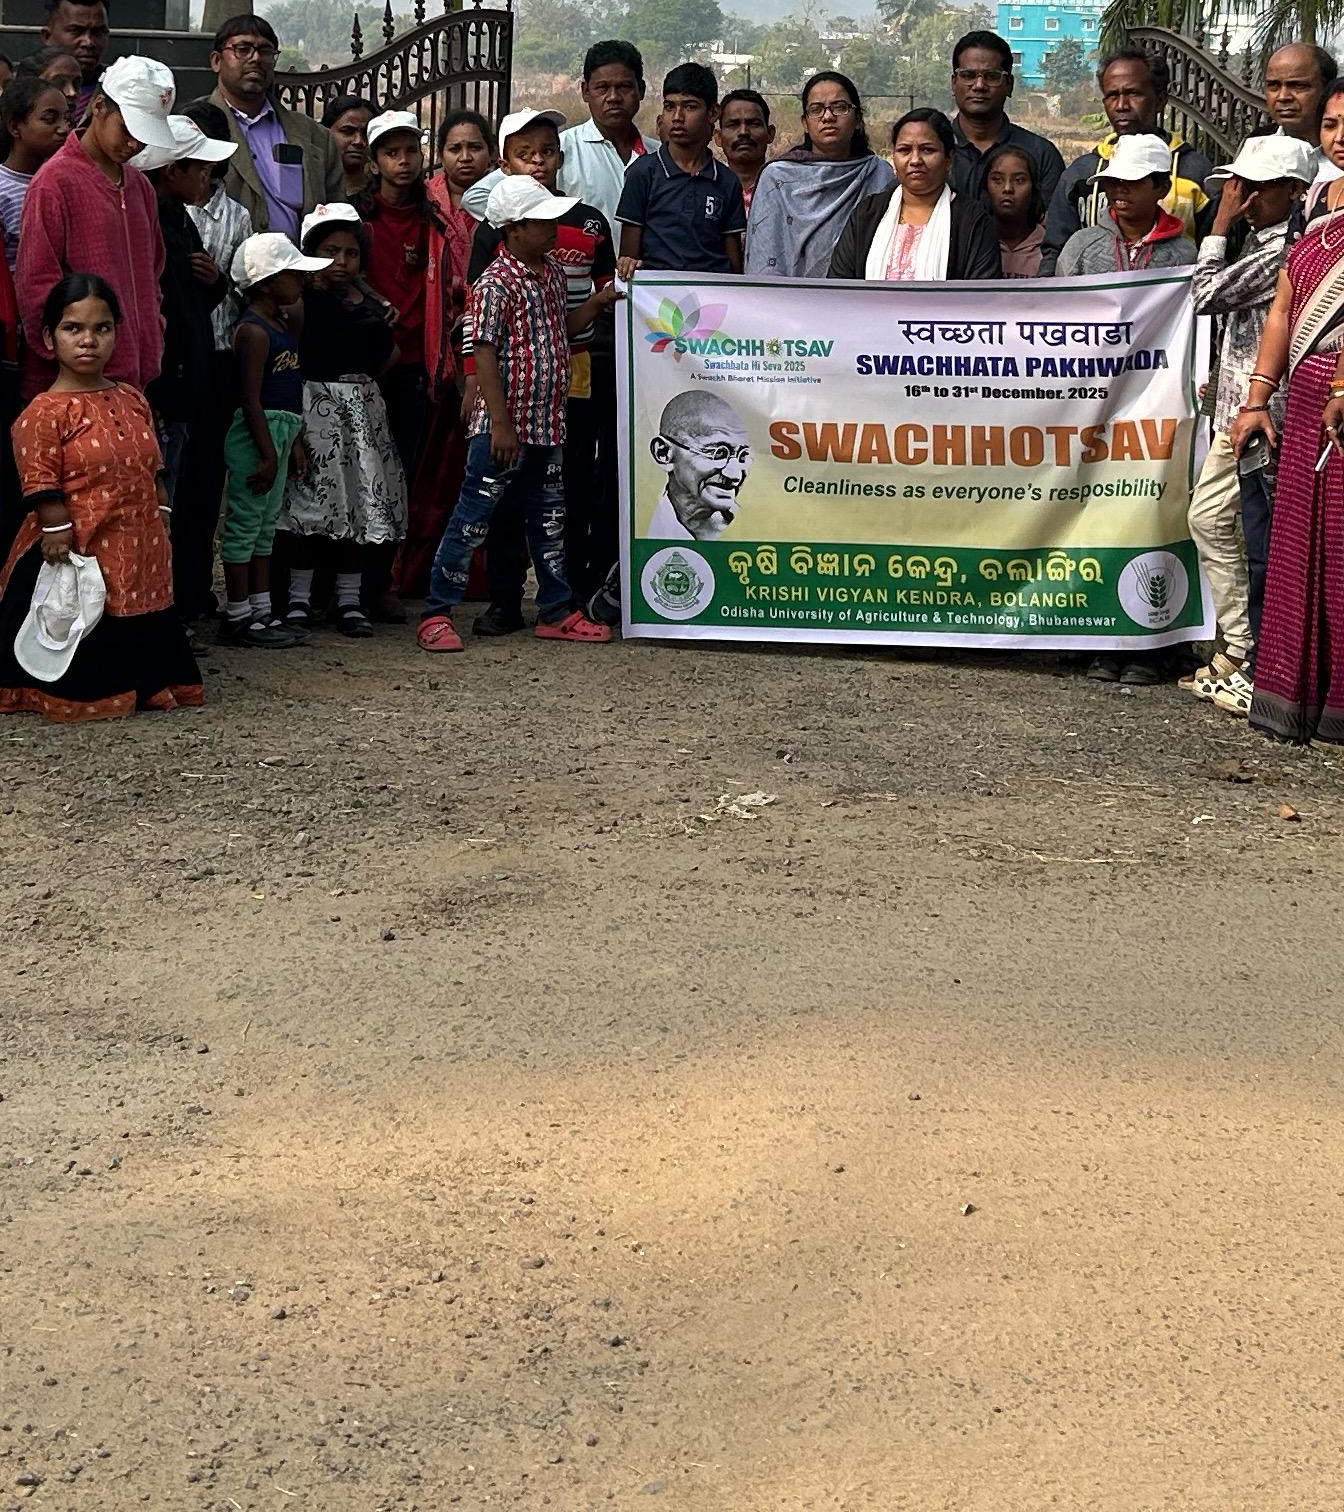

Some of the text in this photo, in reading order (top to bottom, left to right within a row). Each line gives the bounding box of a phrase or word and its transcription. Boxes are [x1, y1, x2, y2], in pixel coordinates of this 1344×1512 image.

[898, 320, 1007, 346] स्वच्छता
[784, 361, 806, 371] 2025
[856, 354, 1020, 377] SWACHHATA
[904, 385, 930, 398] 16th
[933, 386, 948, 398] to
[952, 386, 979, 399] 31st
[1067, 387, 1109, 400] 2025
[768, 418, 1178, 467] SWACHHOTSAV
[783, 476, 897, 499] Cleanliness
[902, 484, 926, 500] as
[1048, 478, 1168, 502] resposibility
[728, 545, 778, 585] କୃଷି
[789, 545, 876, 577] ବିଜ୍ଞାନ
[745, 586, 1089, 609] KRISHI VIGYAN KENDRA, BOLANGIR
[720, 606, 1117, 629] Odisha University of Agriculture & Technology, Bhubaneswar
